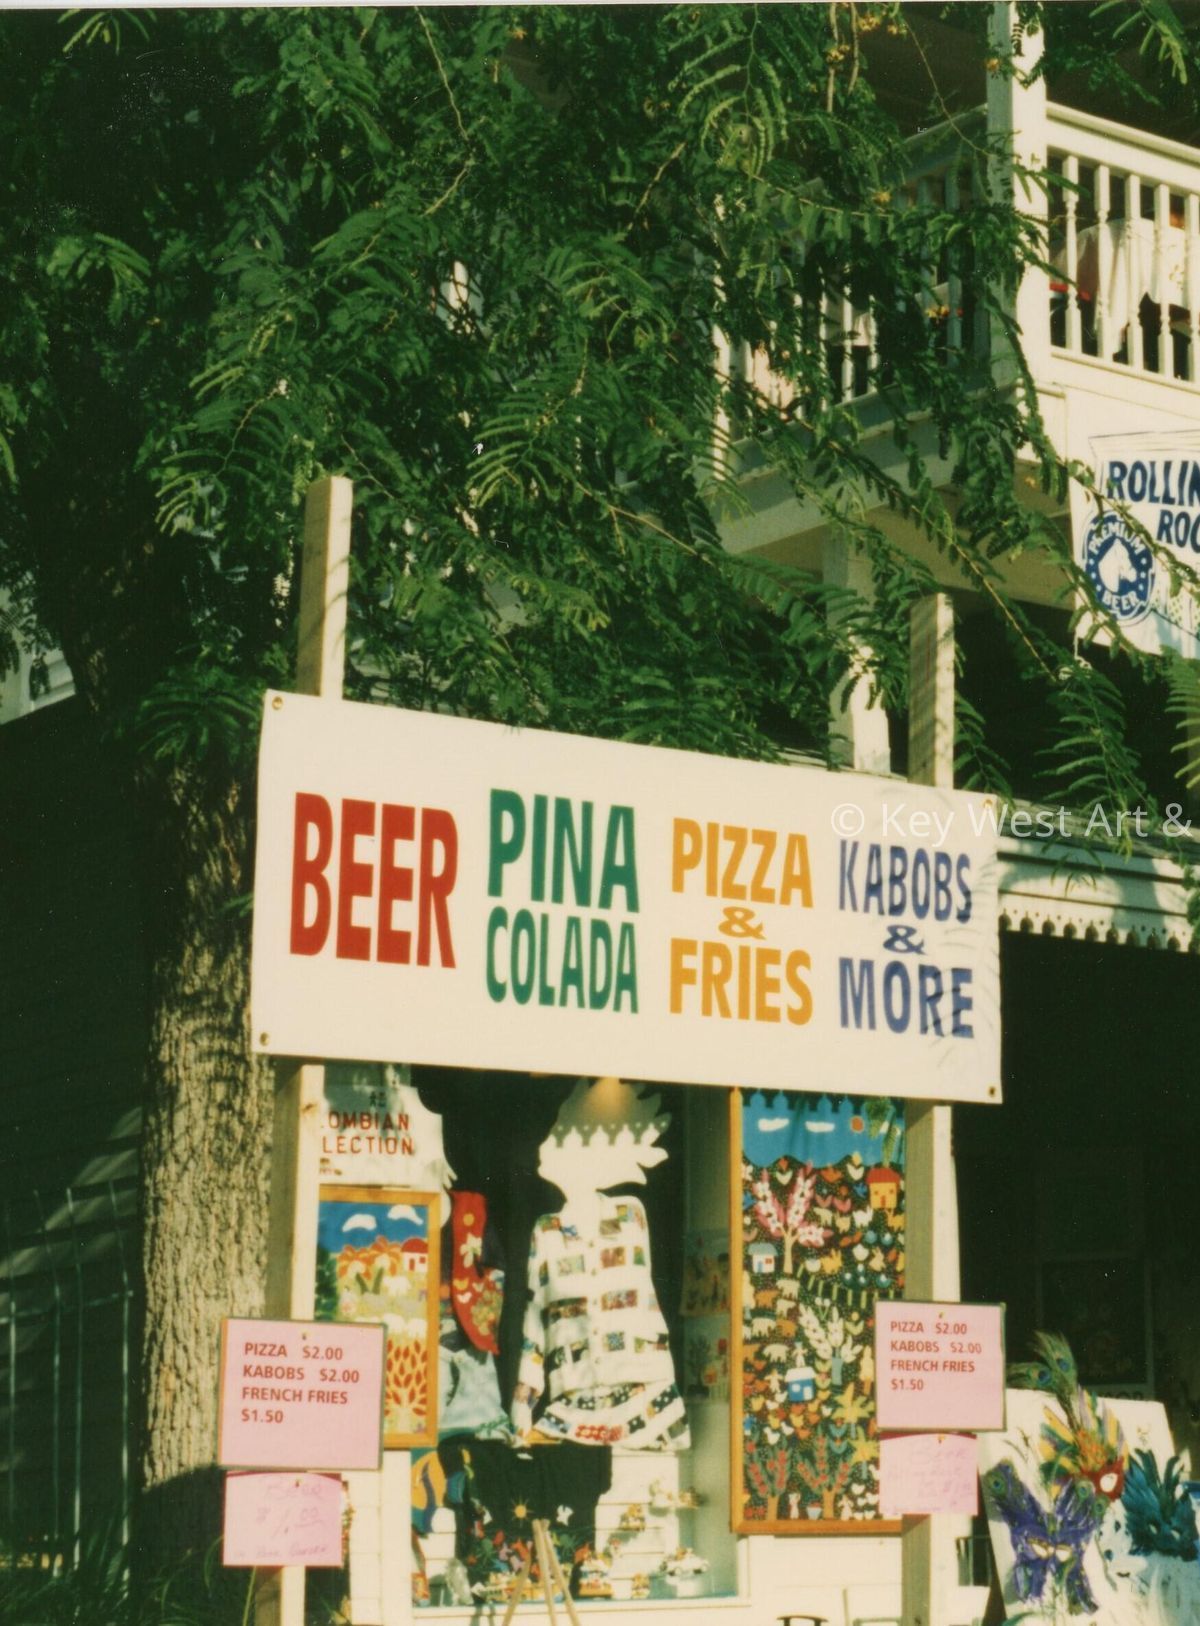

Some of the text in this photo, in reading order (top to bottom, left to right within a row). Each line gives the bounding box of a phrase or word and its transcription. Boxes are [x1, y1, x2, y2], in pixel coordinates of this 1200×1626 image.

[1102, 590, 1138, 611] BEER
[487, 788, 640, 913] PINA
[672, 817, 813, 909] PIZZA
[290, 792, 458, 969] BEER
[838, 839, 974, 924] KABOBS
[718, 906, 767, 940] &
[882, 924, 926, 955] &
[486, 906, 639, 1014] COLADA
[670, 938, 814, 1026] FRIES
[838, 957, 975, 1039] MORE
[320, 1110, 410, 1132] OMBIAN
[322, 1136, 415, 1155] LECTION
[890, 1321, 925, 1334] PIZZA
[244, 1342, 344, 1361] PIZZA $2.00
[890, 1341, 940, 1354] KABOBS
[242, 1365, 360, 1384] KABOBS $2.00
[890, 1360, 975, 1373] FRENCH FRIES
[241, 1386, 349, 1405] FRENCH FRIES
[241, 1408, 284, 1424] $1.50
